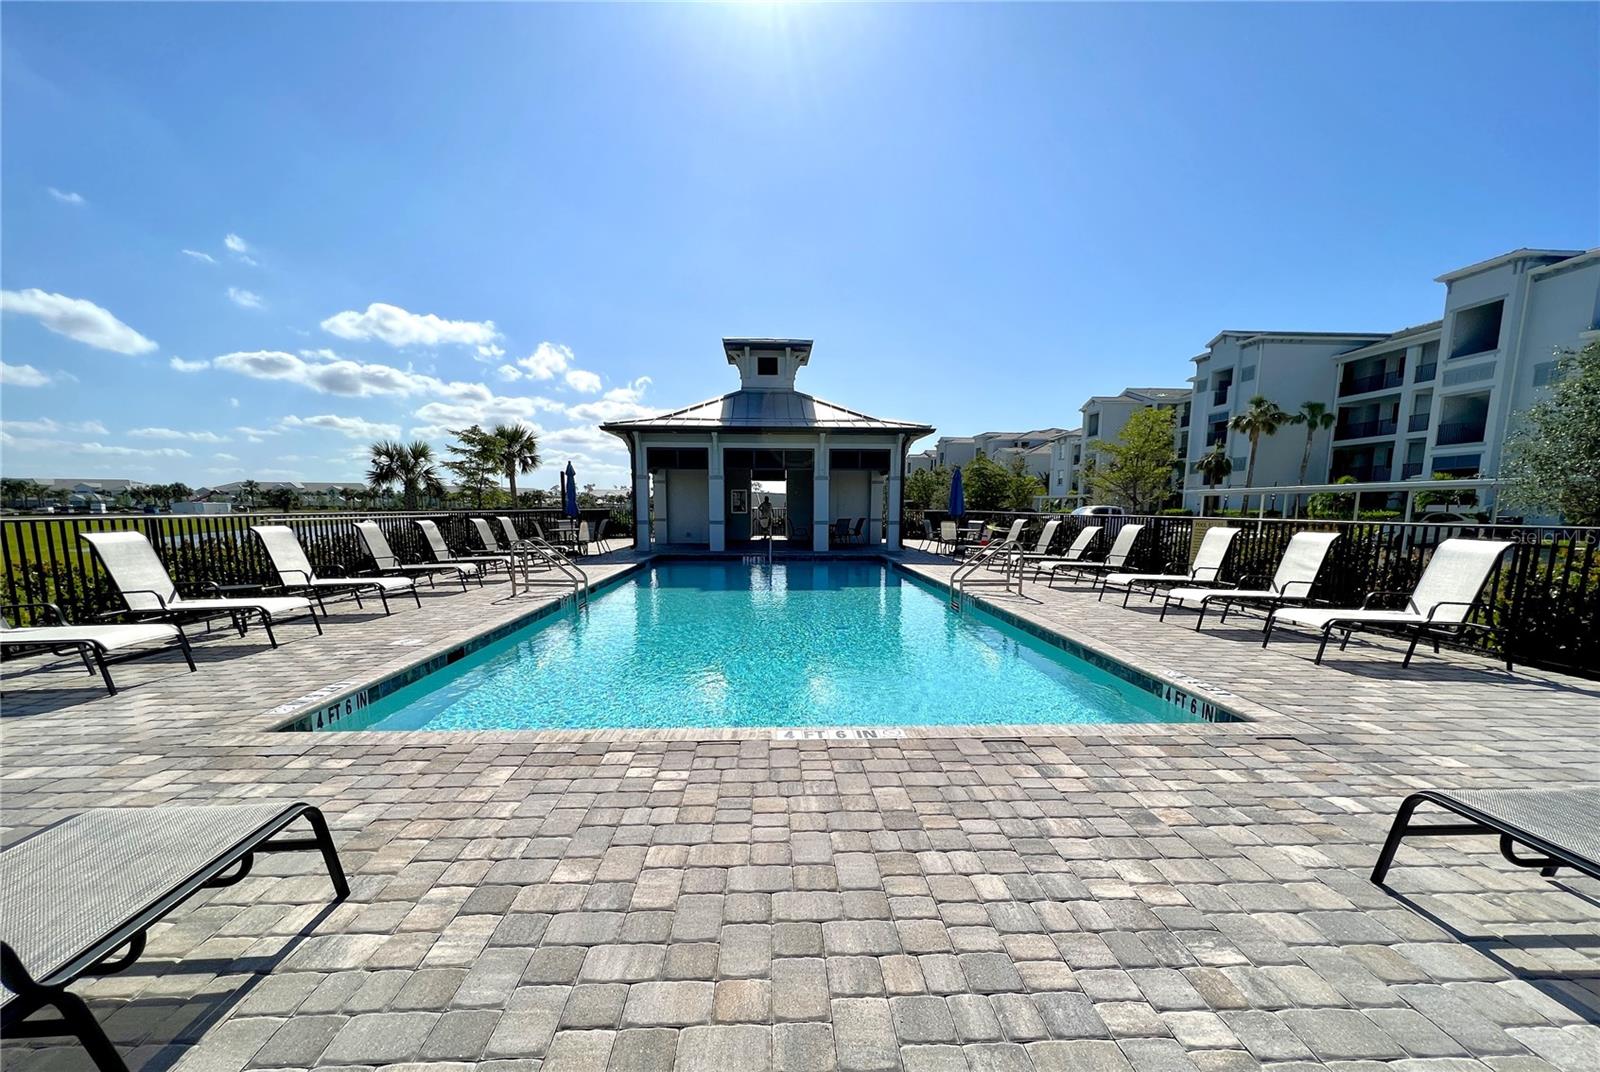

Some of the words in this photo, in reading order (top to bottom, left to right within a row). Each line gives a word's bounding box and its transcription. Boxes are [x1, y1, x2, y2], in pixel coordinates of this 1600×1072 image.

[316, 711, 324, 729] 4
[328, 703, 341, 724] FT
[345, 699, 352, 715] 6
[356, 690, 368, 710] IN
[1165, 687, 1171, 702] 4
[1175, 693, 1187, 709] FT
[1190, 699, 1197, 714] 6
[1201, 702, 1214, 723] IN
[784, 730, 795, 739] 4
[804, 730, 825, 739] FT
[836, 730, 847, 739] 6
[856, 730, 878, 739] IN
